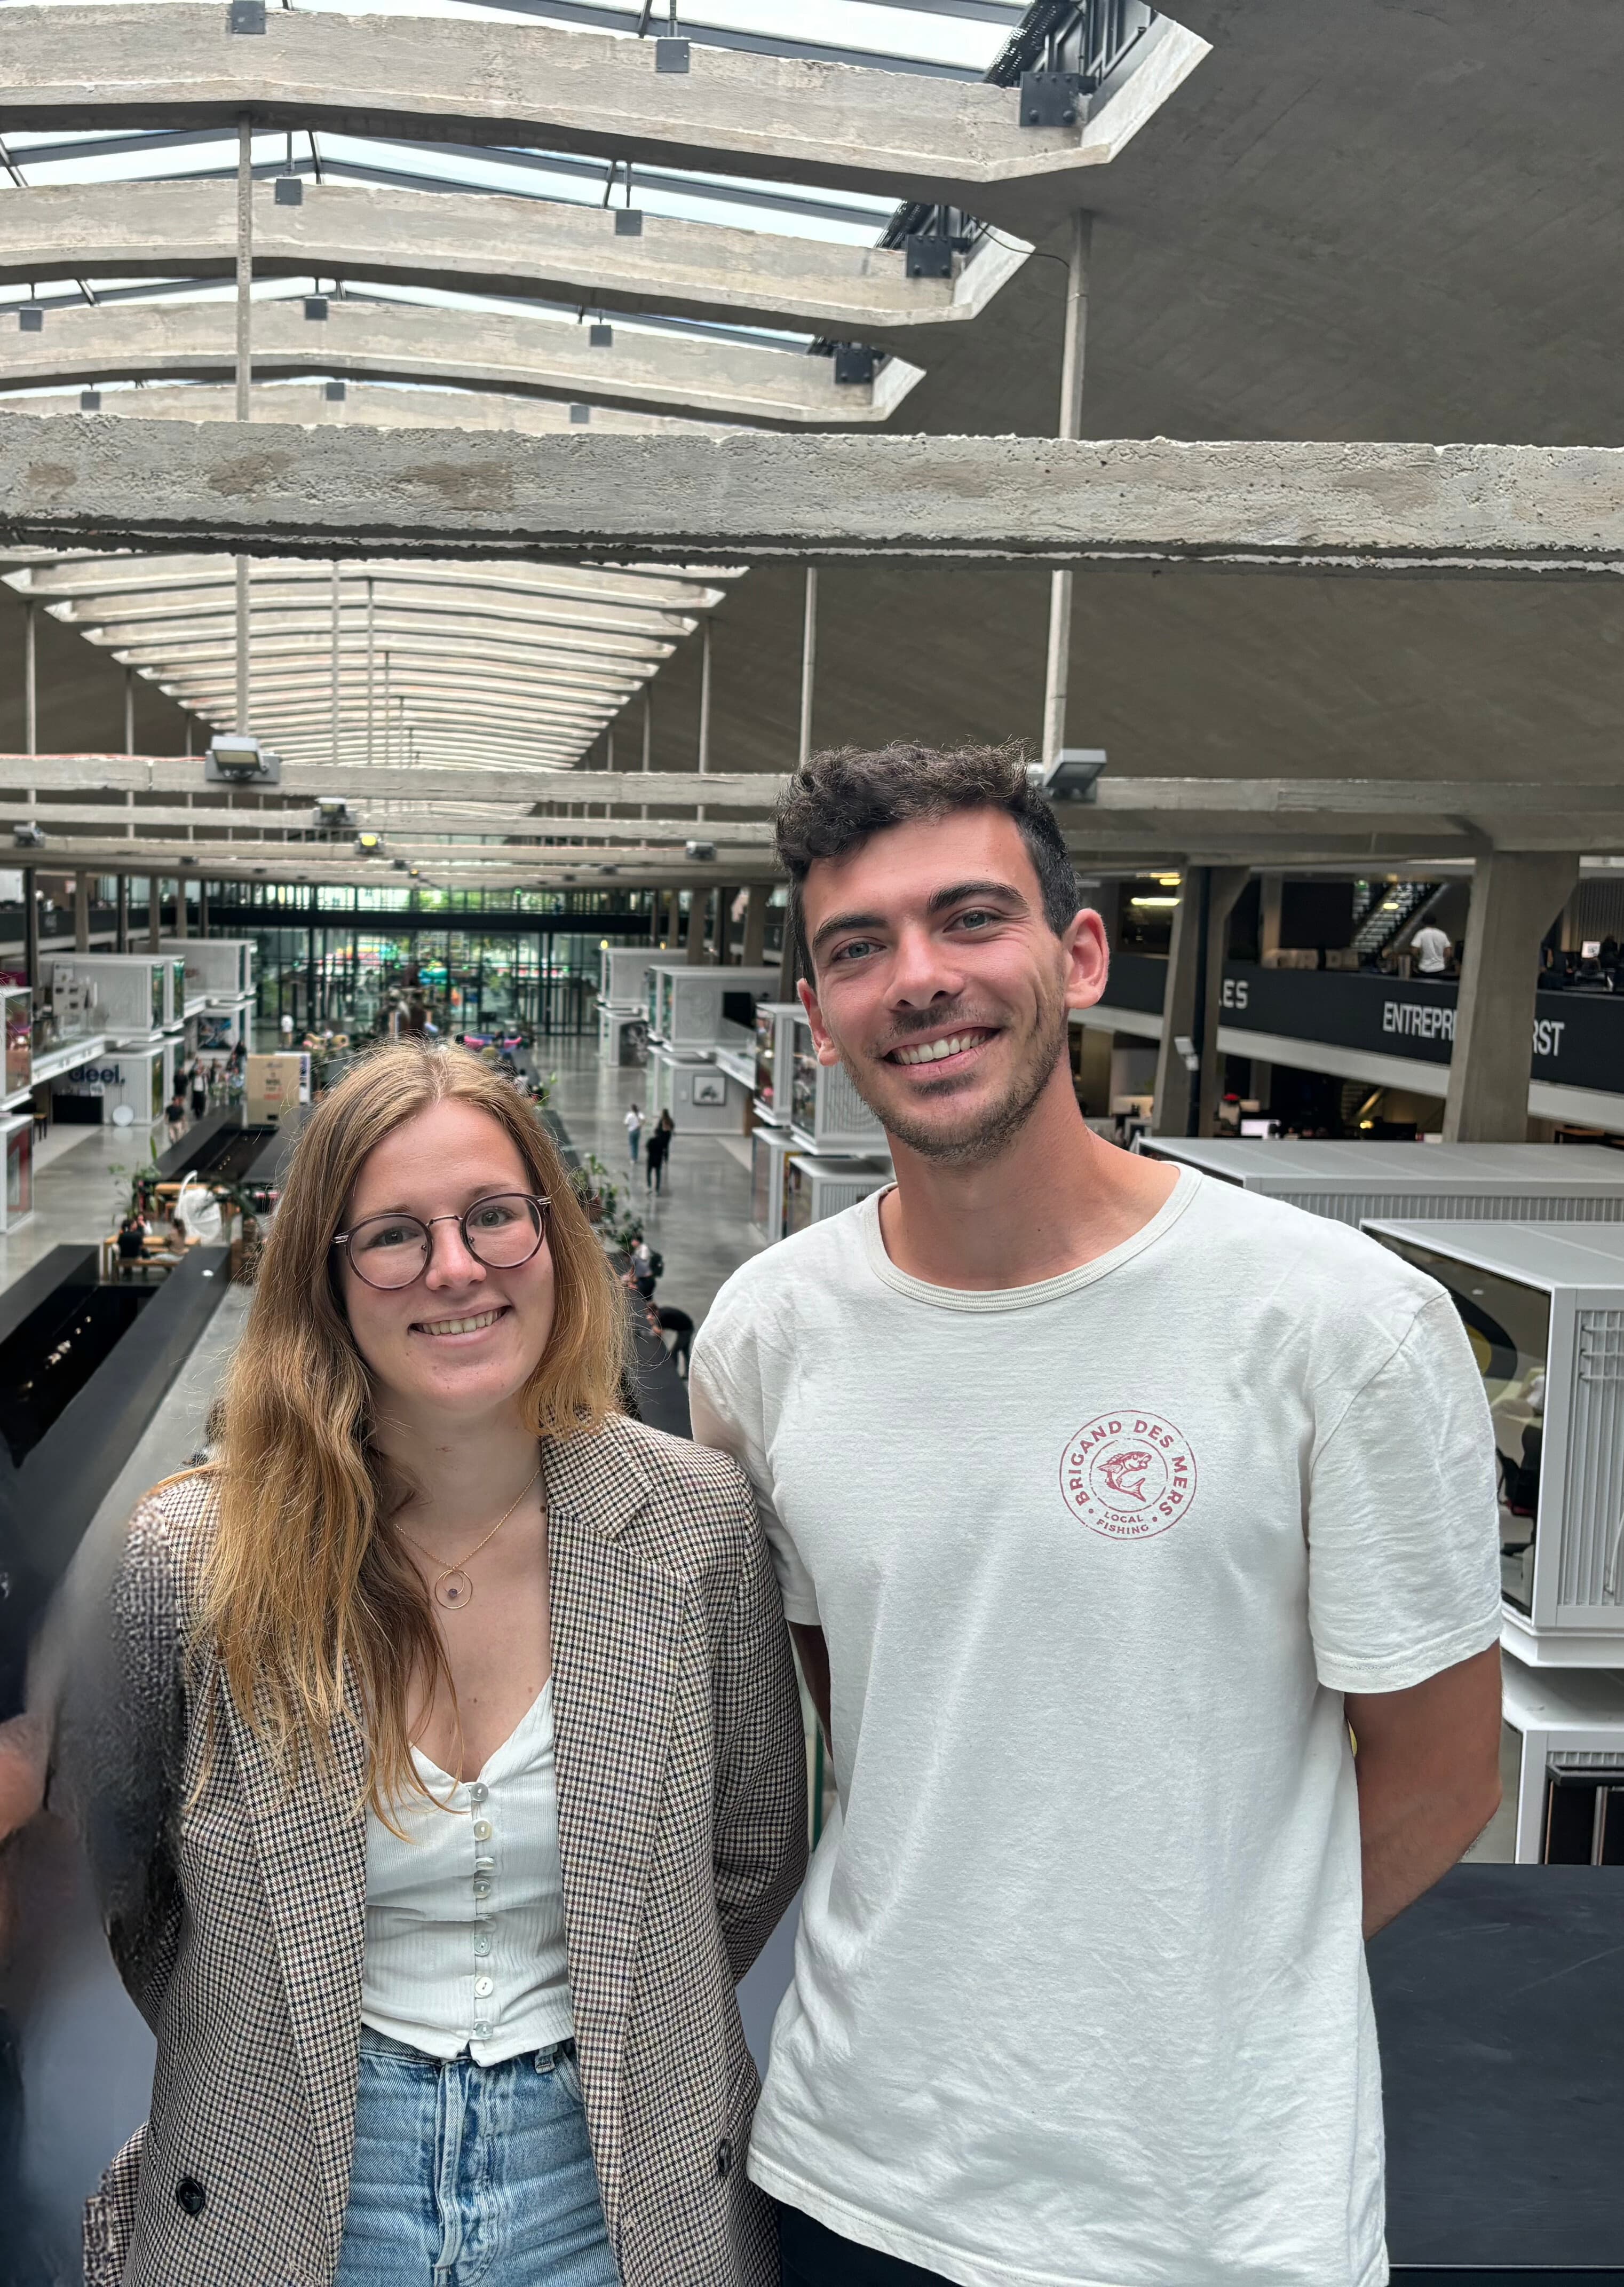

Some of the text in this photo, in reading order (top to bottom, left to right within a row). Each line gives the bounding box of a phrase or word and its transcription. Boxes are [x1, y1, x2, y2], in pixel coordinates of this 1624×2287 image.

[1218, 979, 1248, 1009] ES
[1068, 1420, 1188, 1516] BRIGAND DES MERS
[1097, 1519, 1149, 1534] FISHING
[1104, 1511, 1144, 1523] LOCAL
